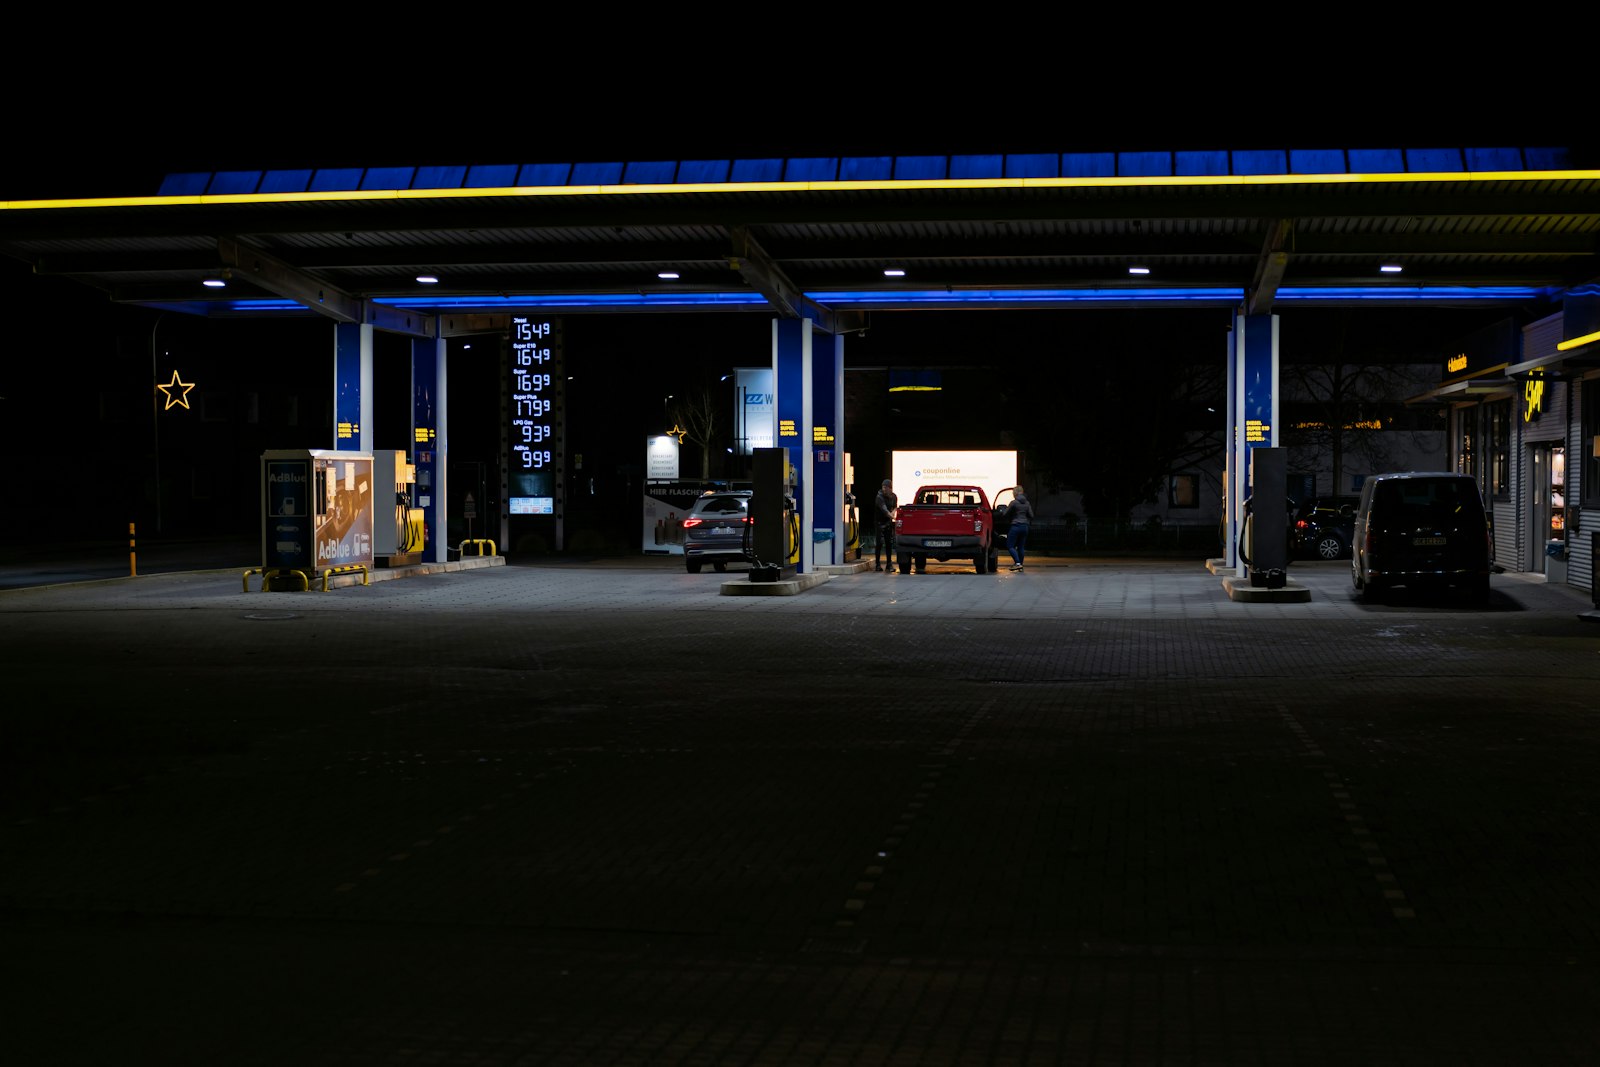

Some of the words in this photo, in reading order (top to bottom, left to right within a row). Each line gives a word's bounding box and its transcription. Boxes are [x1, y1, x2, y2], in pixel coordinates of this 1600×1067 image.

[517, 323, 550, 340] 1549
[517, 349, 550, 365] 1649
[517, 375, 550, 391] 1699
[517, 400, 551, 416] 1799
[522, 426, 550, 442] 939
[522, 451, 550, 468] 999
[269, 472, 306, 482] AdBlue
[923, 467, 960, 475] couponline
[318, 538, 350, 559] AdBlue
